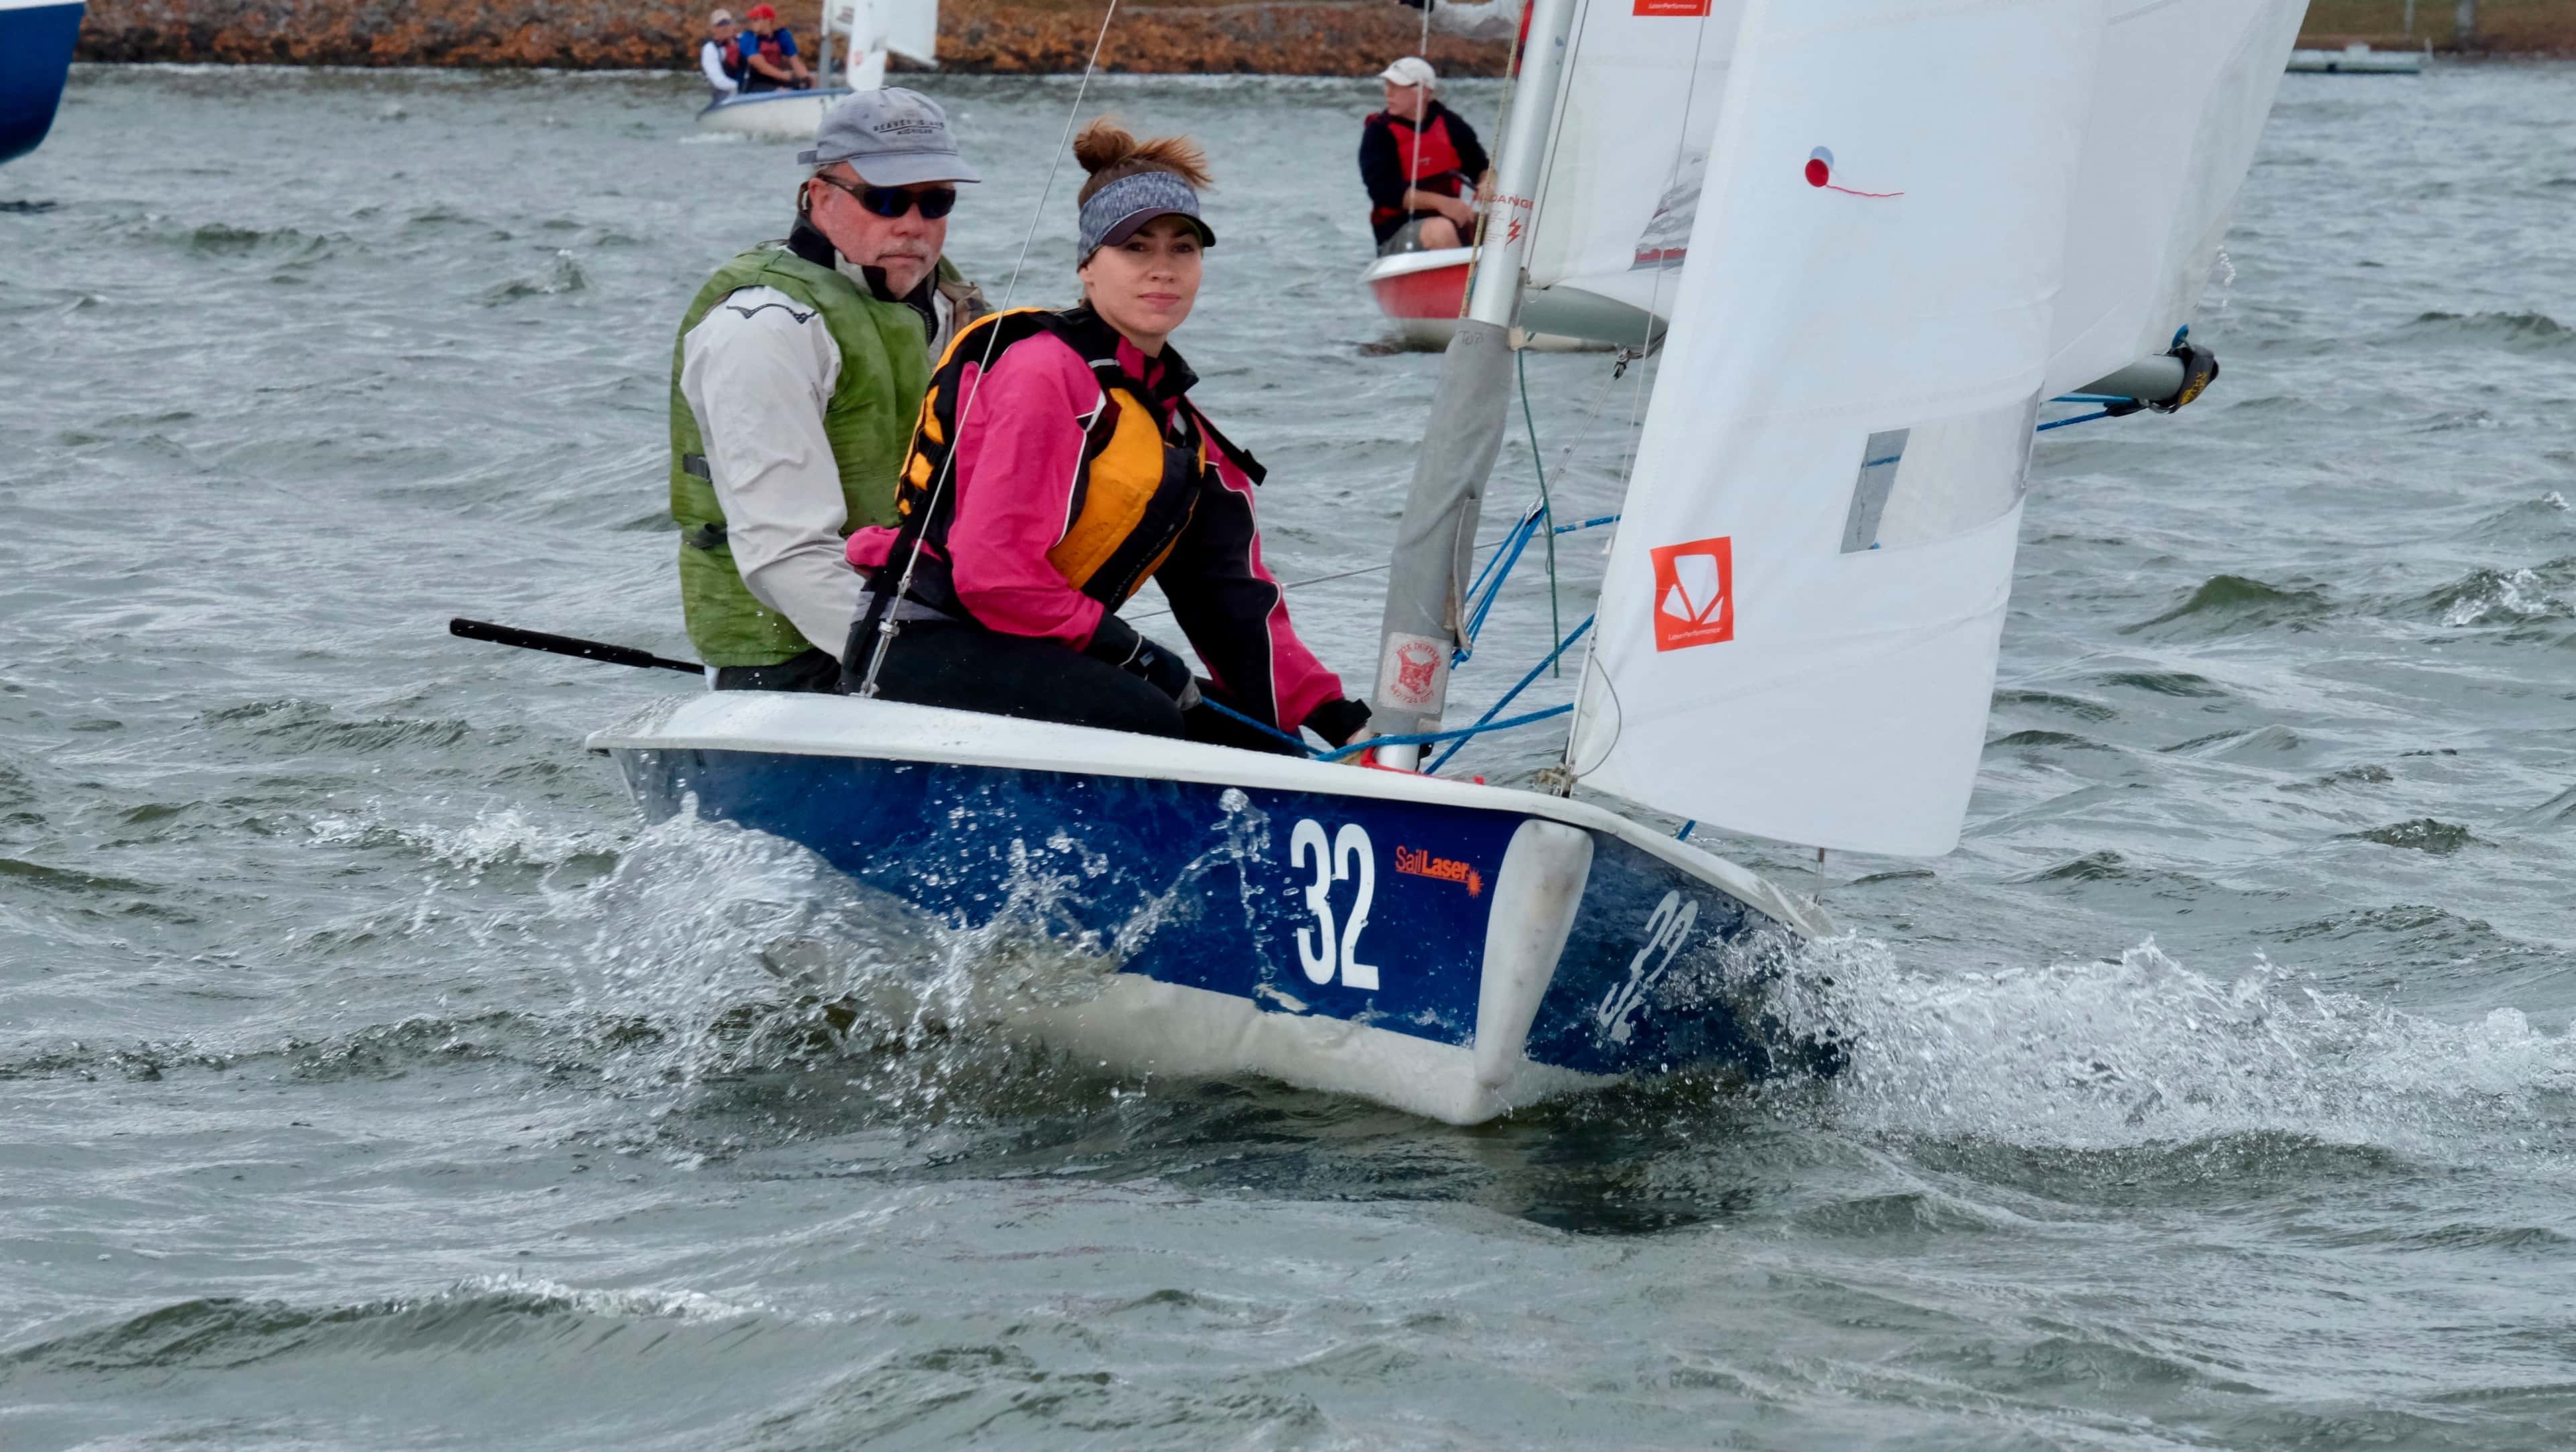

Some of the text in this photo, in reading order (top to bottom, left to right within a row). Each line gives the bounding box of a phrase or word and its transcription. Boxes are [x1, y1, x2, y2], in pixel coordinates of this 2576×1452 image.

[1491, 194, 1534, 210] DANGE
[1290, 818, 1379, 991] 32
[1598, 890, 1699, 1042] 32
